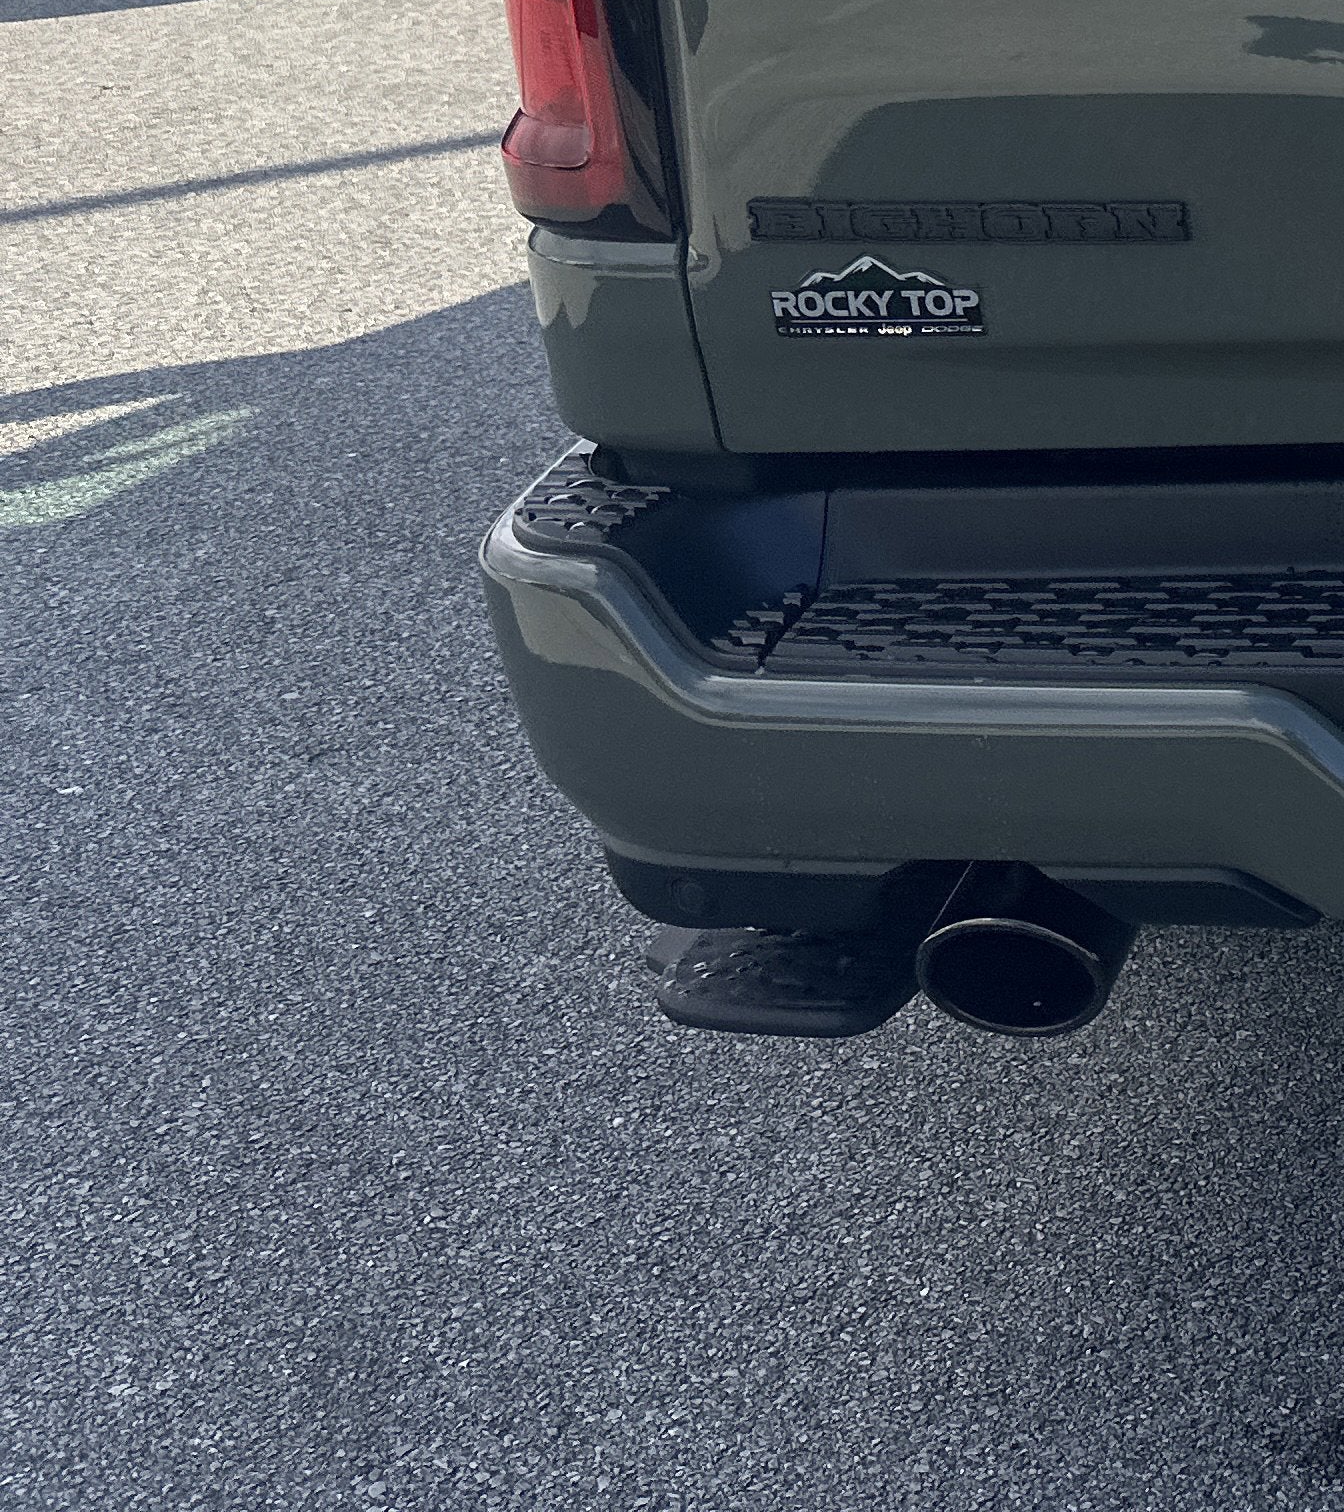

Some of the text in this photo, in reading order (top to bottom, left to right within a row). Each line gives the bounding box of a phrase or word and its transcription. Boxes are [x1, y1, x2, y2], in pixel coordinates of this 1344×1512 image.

[771, 289, 979, 317] ROCKY TOP
[778, 323, 984, 336] CHRYSLER Jeep DODGE
